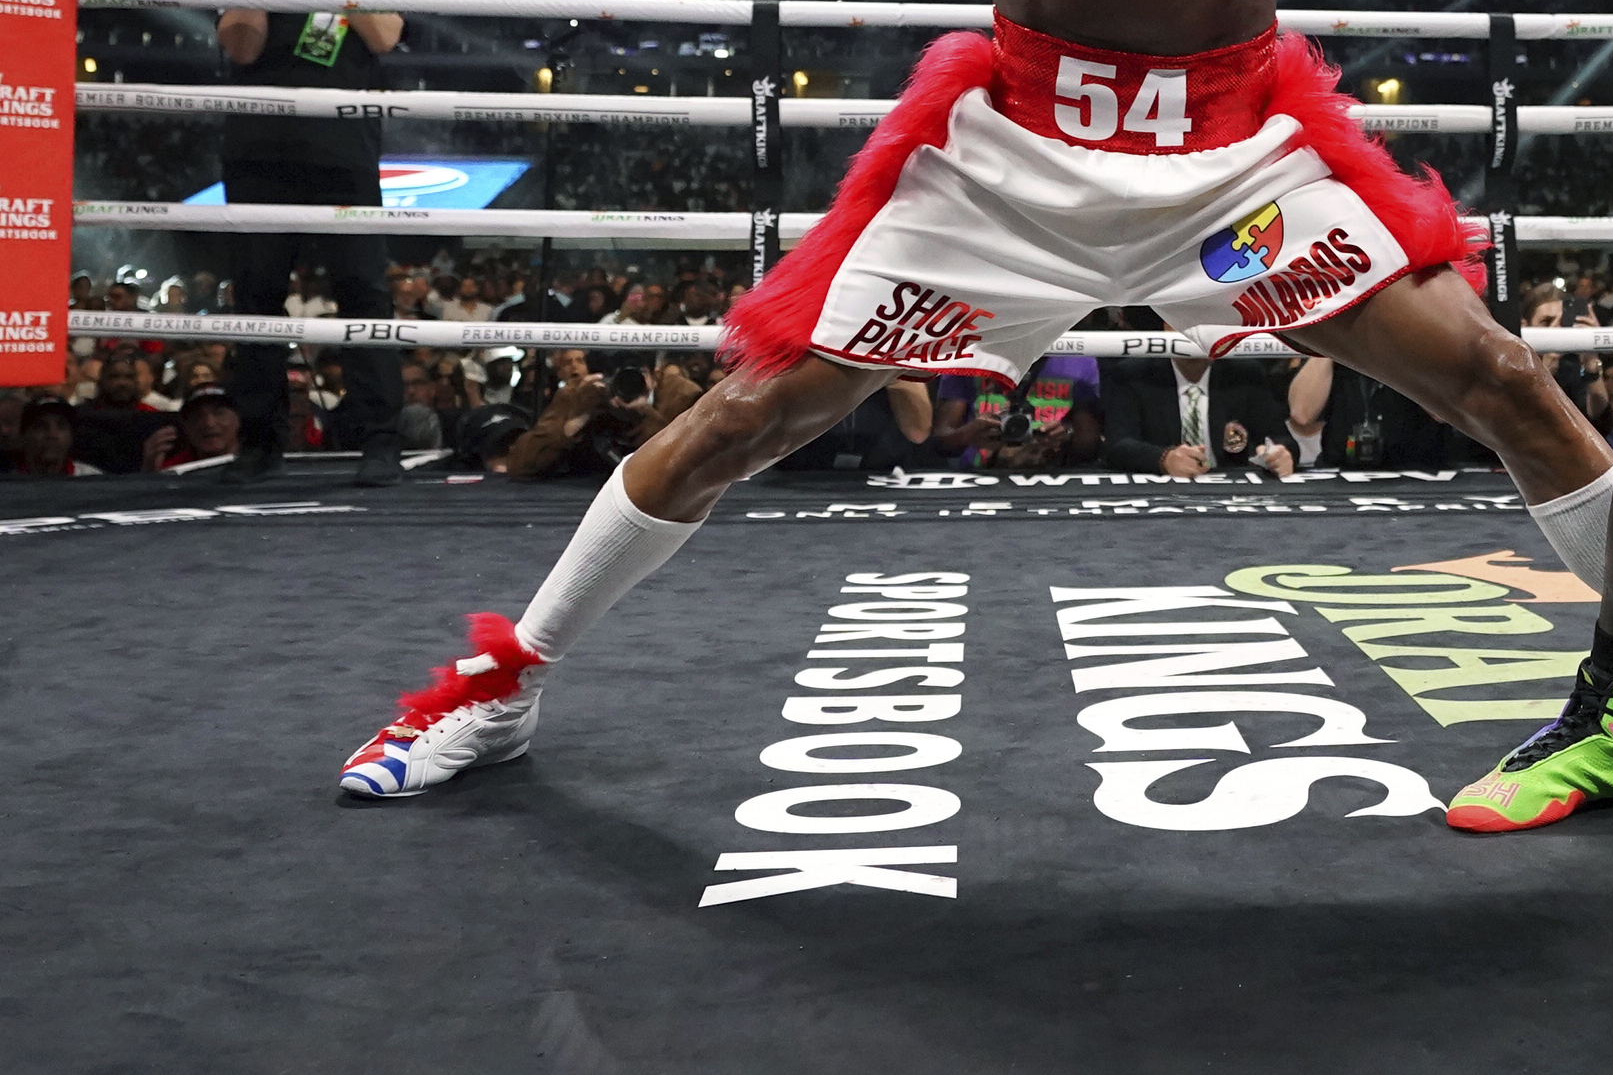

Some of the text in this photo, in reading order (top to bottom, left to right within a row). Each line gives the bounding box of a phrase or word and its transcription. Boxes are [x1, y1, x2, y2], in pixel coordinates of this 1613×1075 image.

[0, 85, 56, 102] RAFT
[1053, 55, 1191, 147] 54
[0, 99, 53, 115] INGS
[76, 92, 297, 116] EMIER BOXING CHAMPIONS
[839, 117, 884, 126] PREM
[1363, 119, 1439, 130] HAMPIONS
[0, 198, 53, 213] RAFT
[0, 213, 51, 227] INGS
[876, 282, 995, 337] SHOE
[0, 311, 51, 326] RAFT
[72, 315, 304, 335] REMIER BOXING CHAMPIONS
[0, 326, 48, 340] INGS
[343, 324, 418, 343] PBC
[462, 328, 700, 343] PREMIER BOXING CHAMPIONS
[1122, 338, 1191, 355] PBC
[1234, 342, 1289, 352] PREMIE
[1049, 585, 1448, 831] KINGS
[698, 571, 971, 908] SPORTSBOOK
